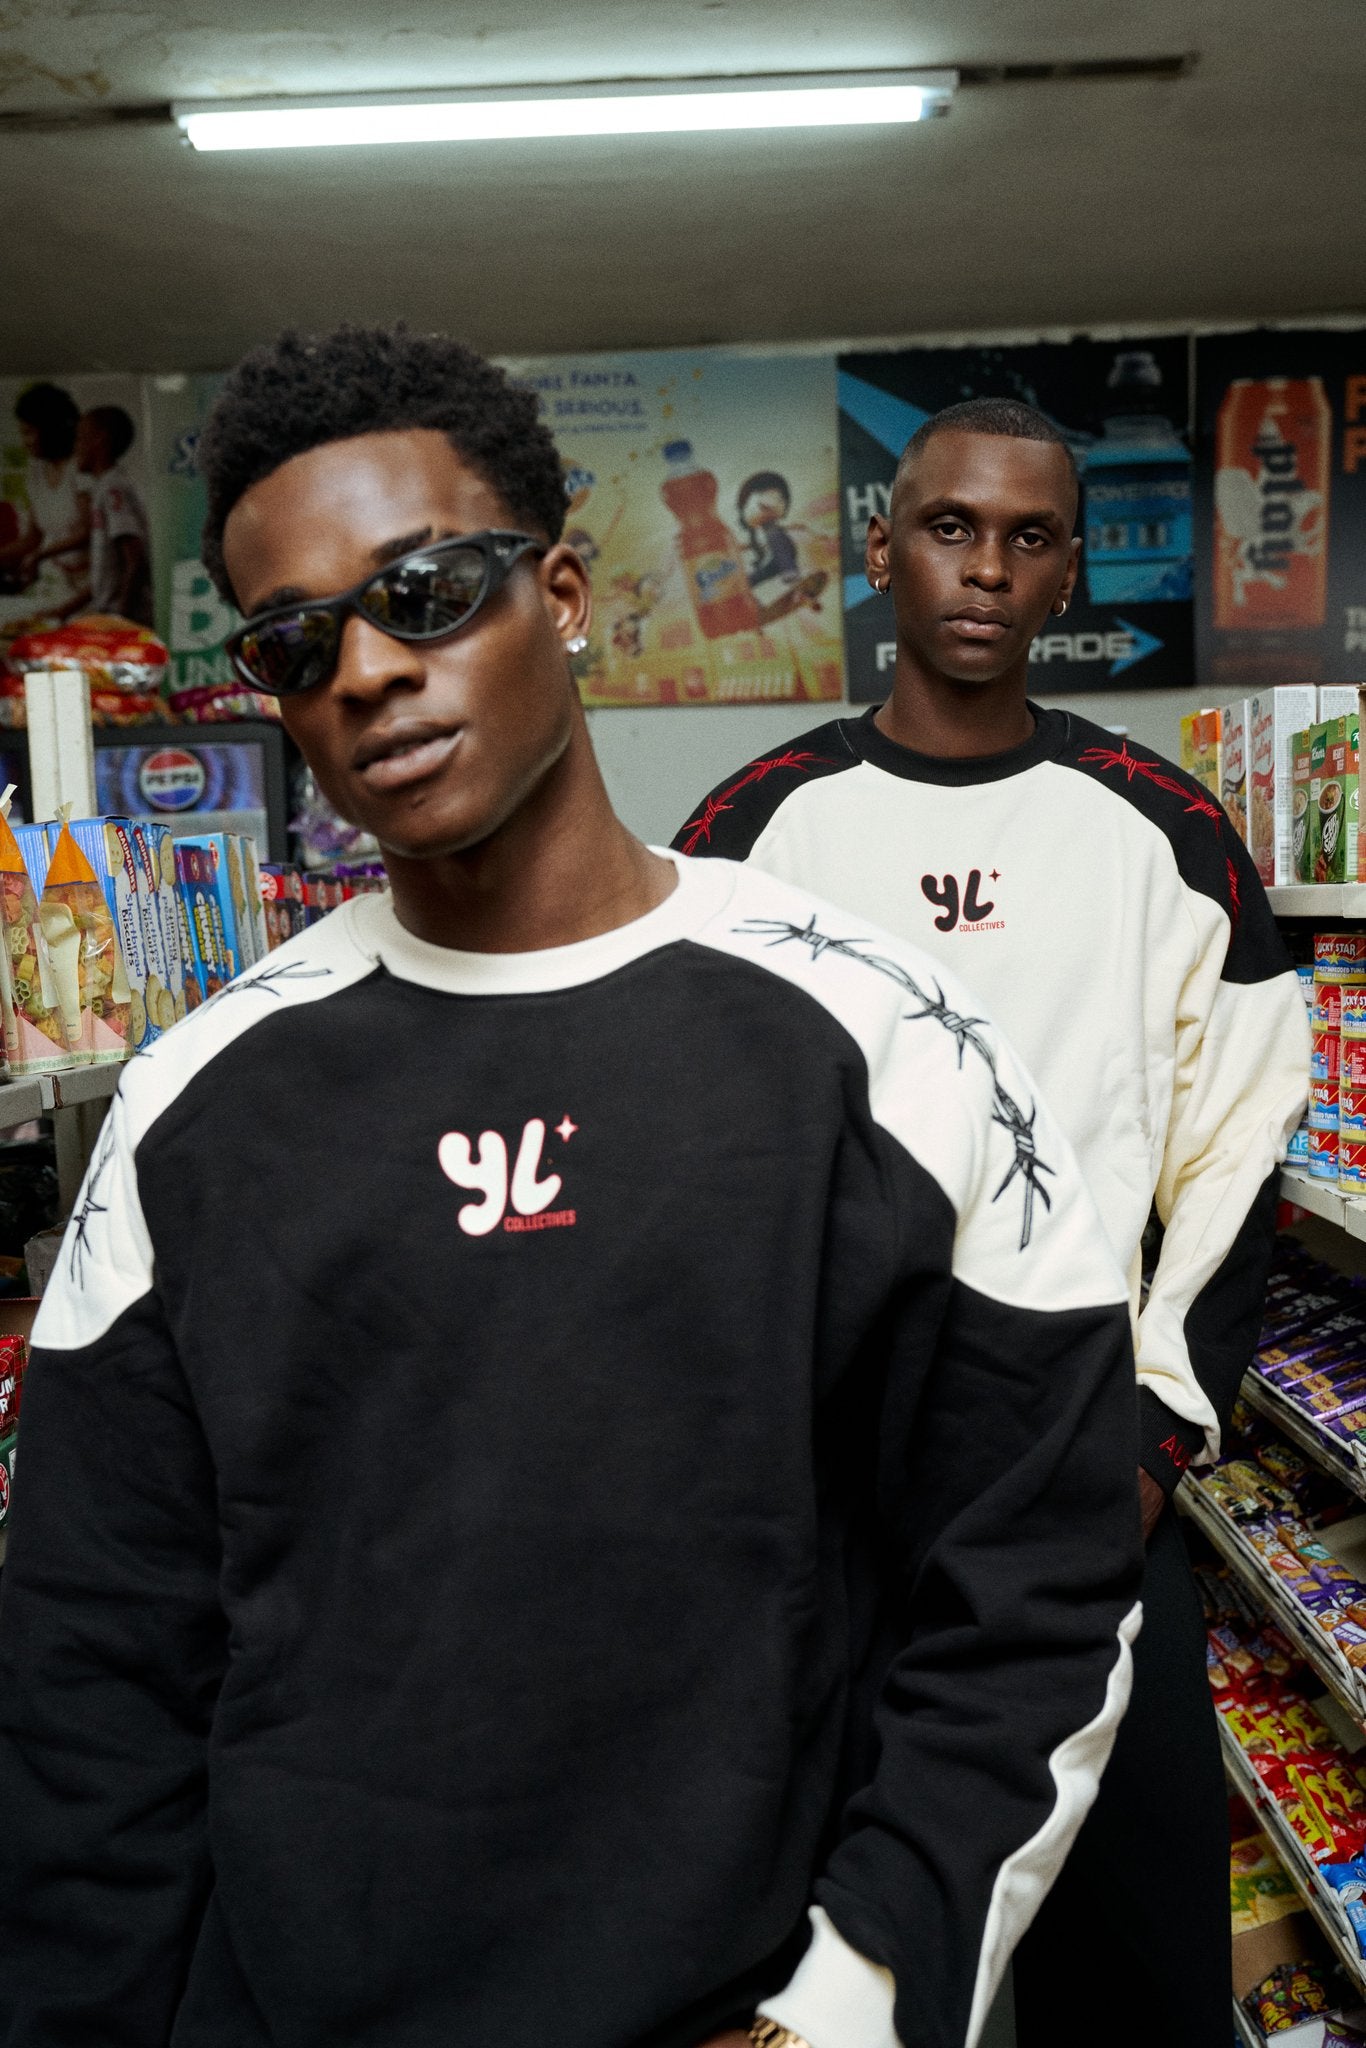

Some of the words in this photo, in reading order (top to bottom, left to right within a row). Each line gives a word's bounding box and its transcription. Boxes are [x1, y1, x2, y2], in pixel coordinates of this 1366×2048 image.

[846, 481, 894, 520] HY
[125, 893, 143, 977] Shortbread
[195, 891, 217, 974] CHUNKY
[959, 921, 1005, 932] COLLECTIVES
[1335, 943, 1356, 956] STAR
[503, 1209, 577, 1232] COLLECTIVES
